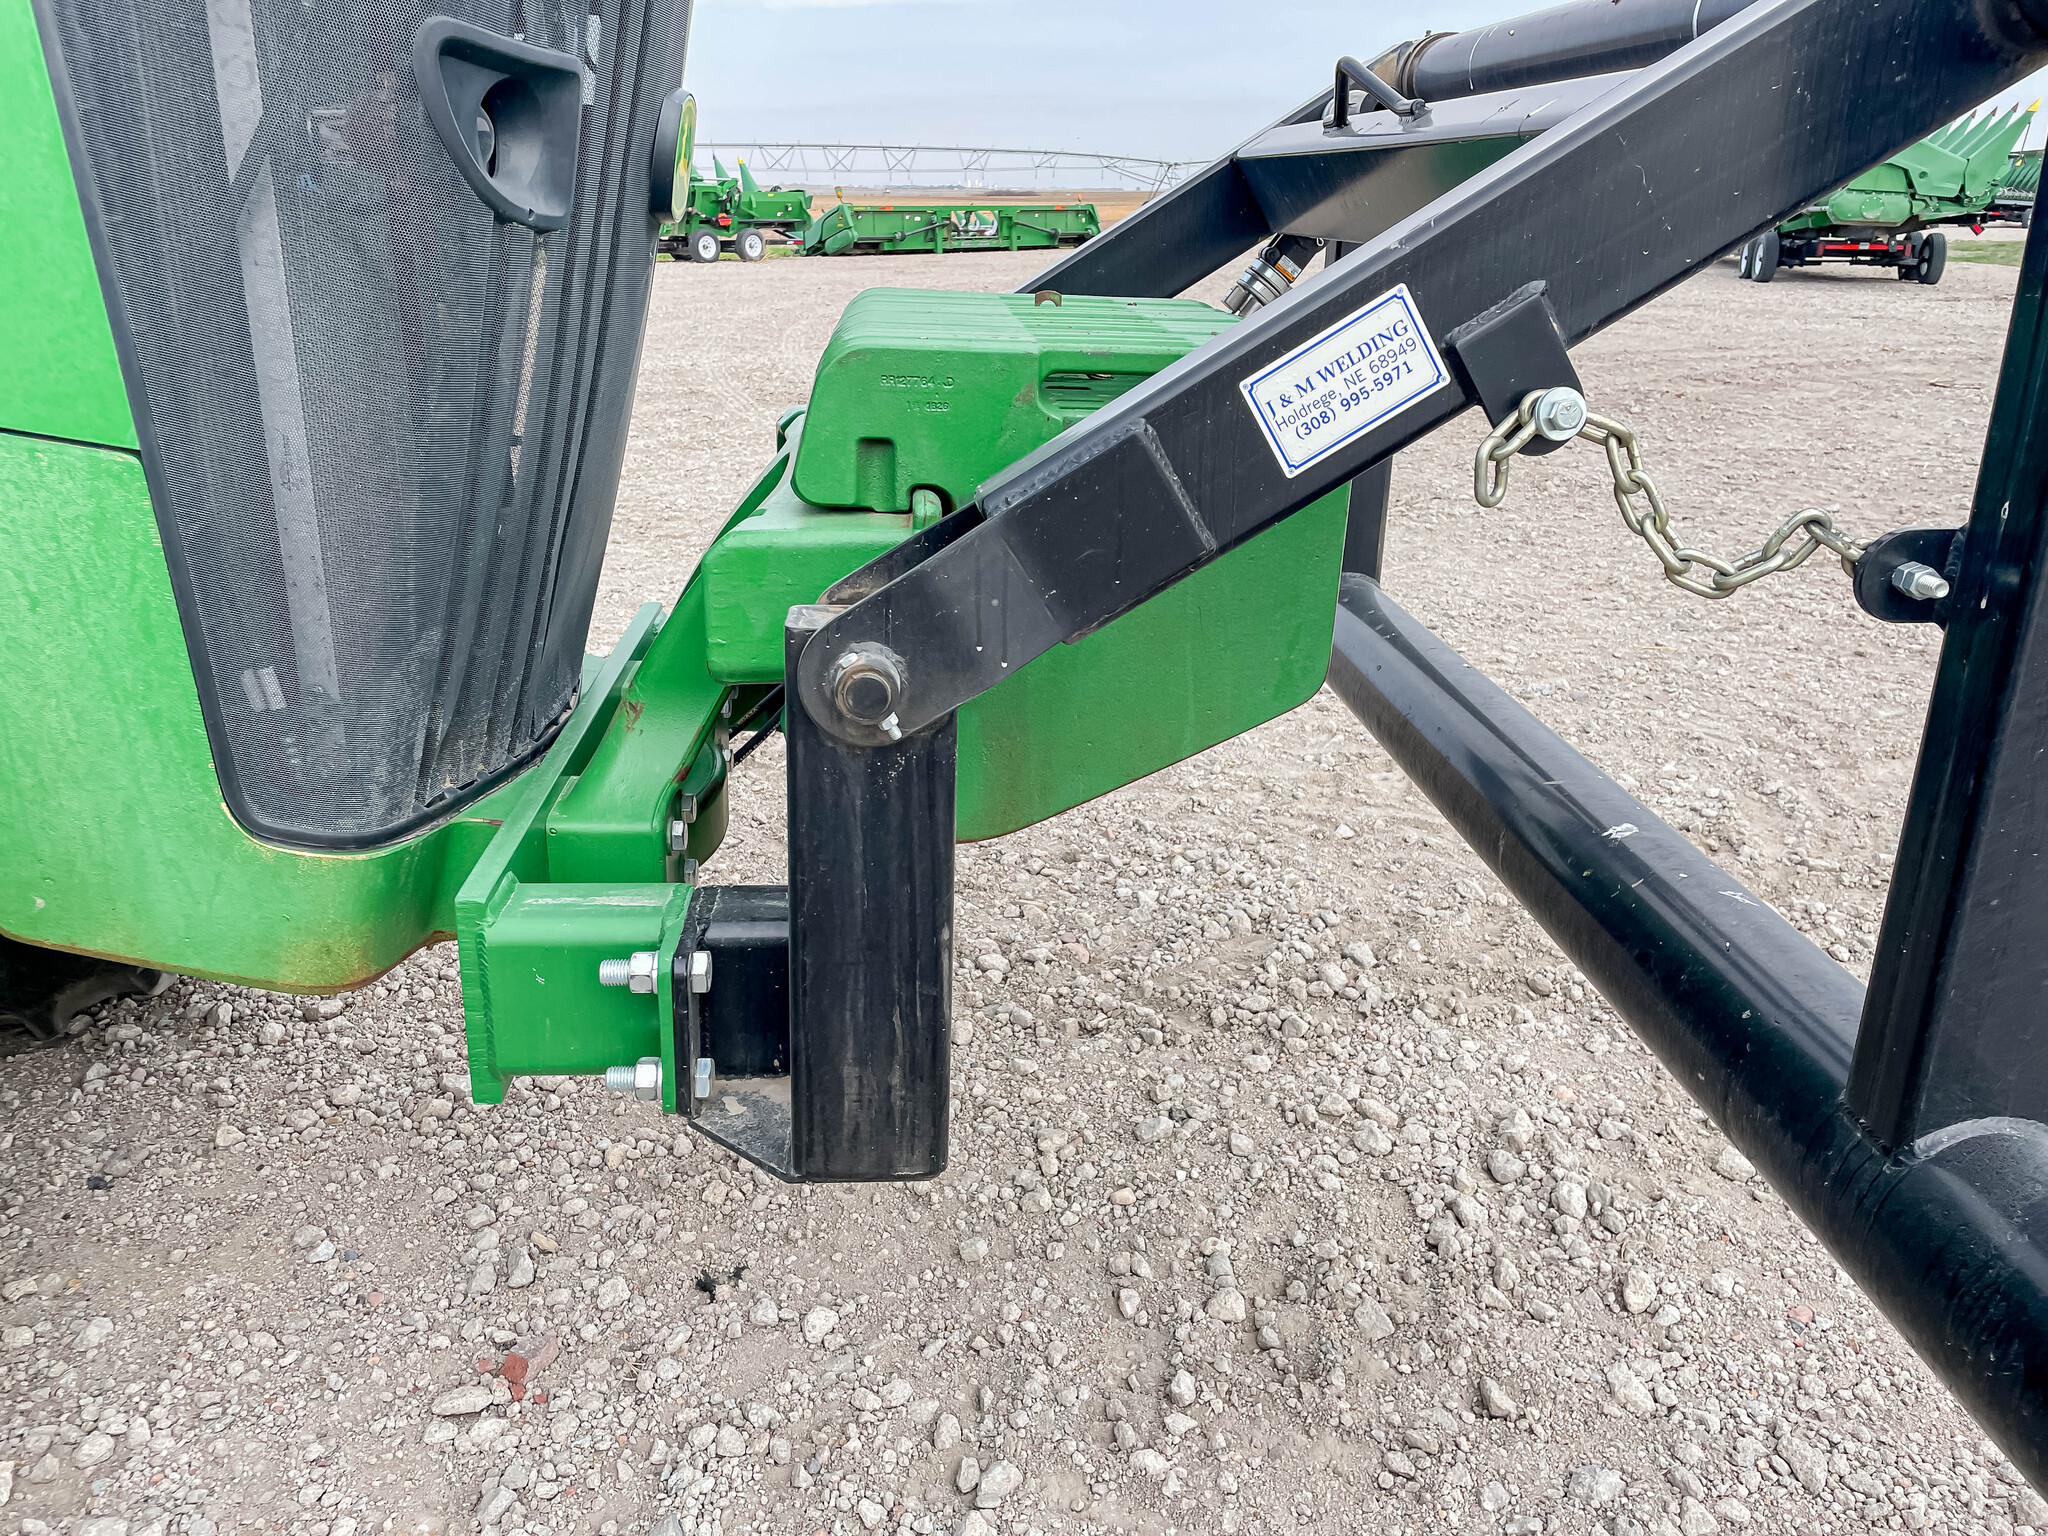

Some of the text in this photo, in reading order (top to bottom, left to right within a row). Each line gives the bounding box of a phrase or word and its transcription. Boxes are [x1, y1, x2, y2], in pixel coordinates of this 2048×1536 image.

[1265, 319, 1410, 420] J & M WELDING
[1275, 337, 1418, 432] Holdrege, NE 68949
[1295, 361, 1413, 440] (308) 995-5971
